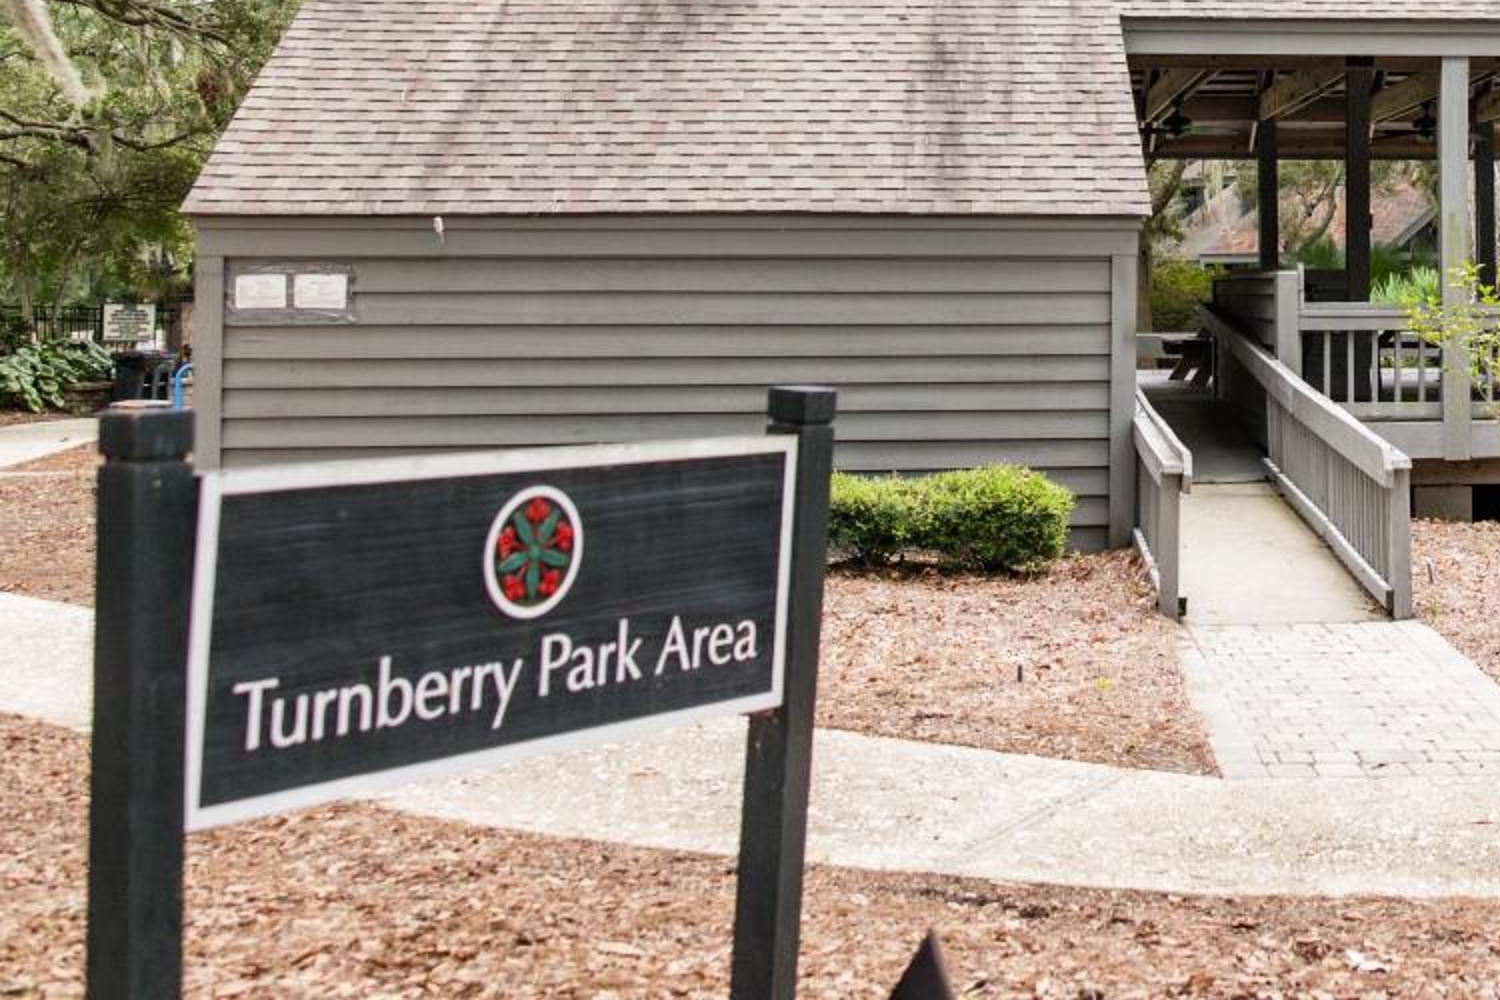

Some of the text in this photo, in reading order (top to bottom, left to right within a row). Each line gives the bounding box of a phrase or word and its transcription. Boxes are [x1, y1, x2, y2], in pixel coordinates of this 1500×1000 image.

[233, 615, 758, 751] Turnberry Park Area
